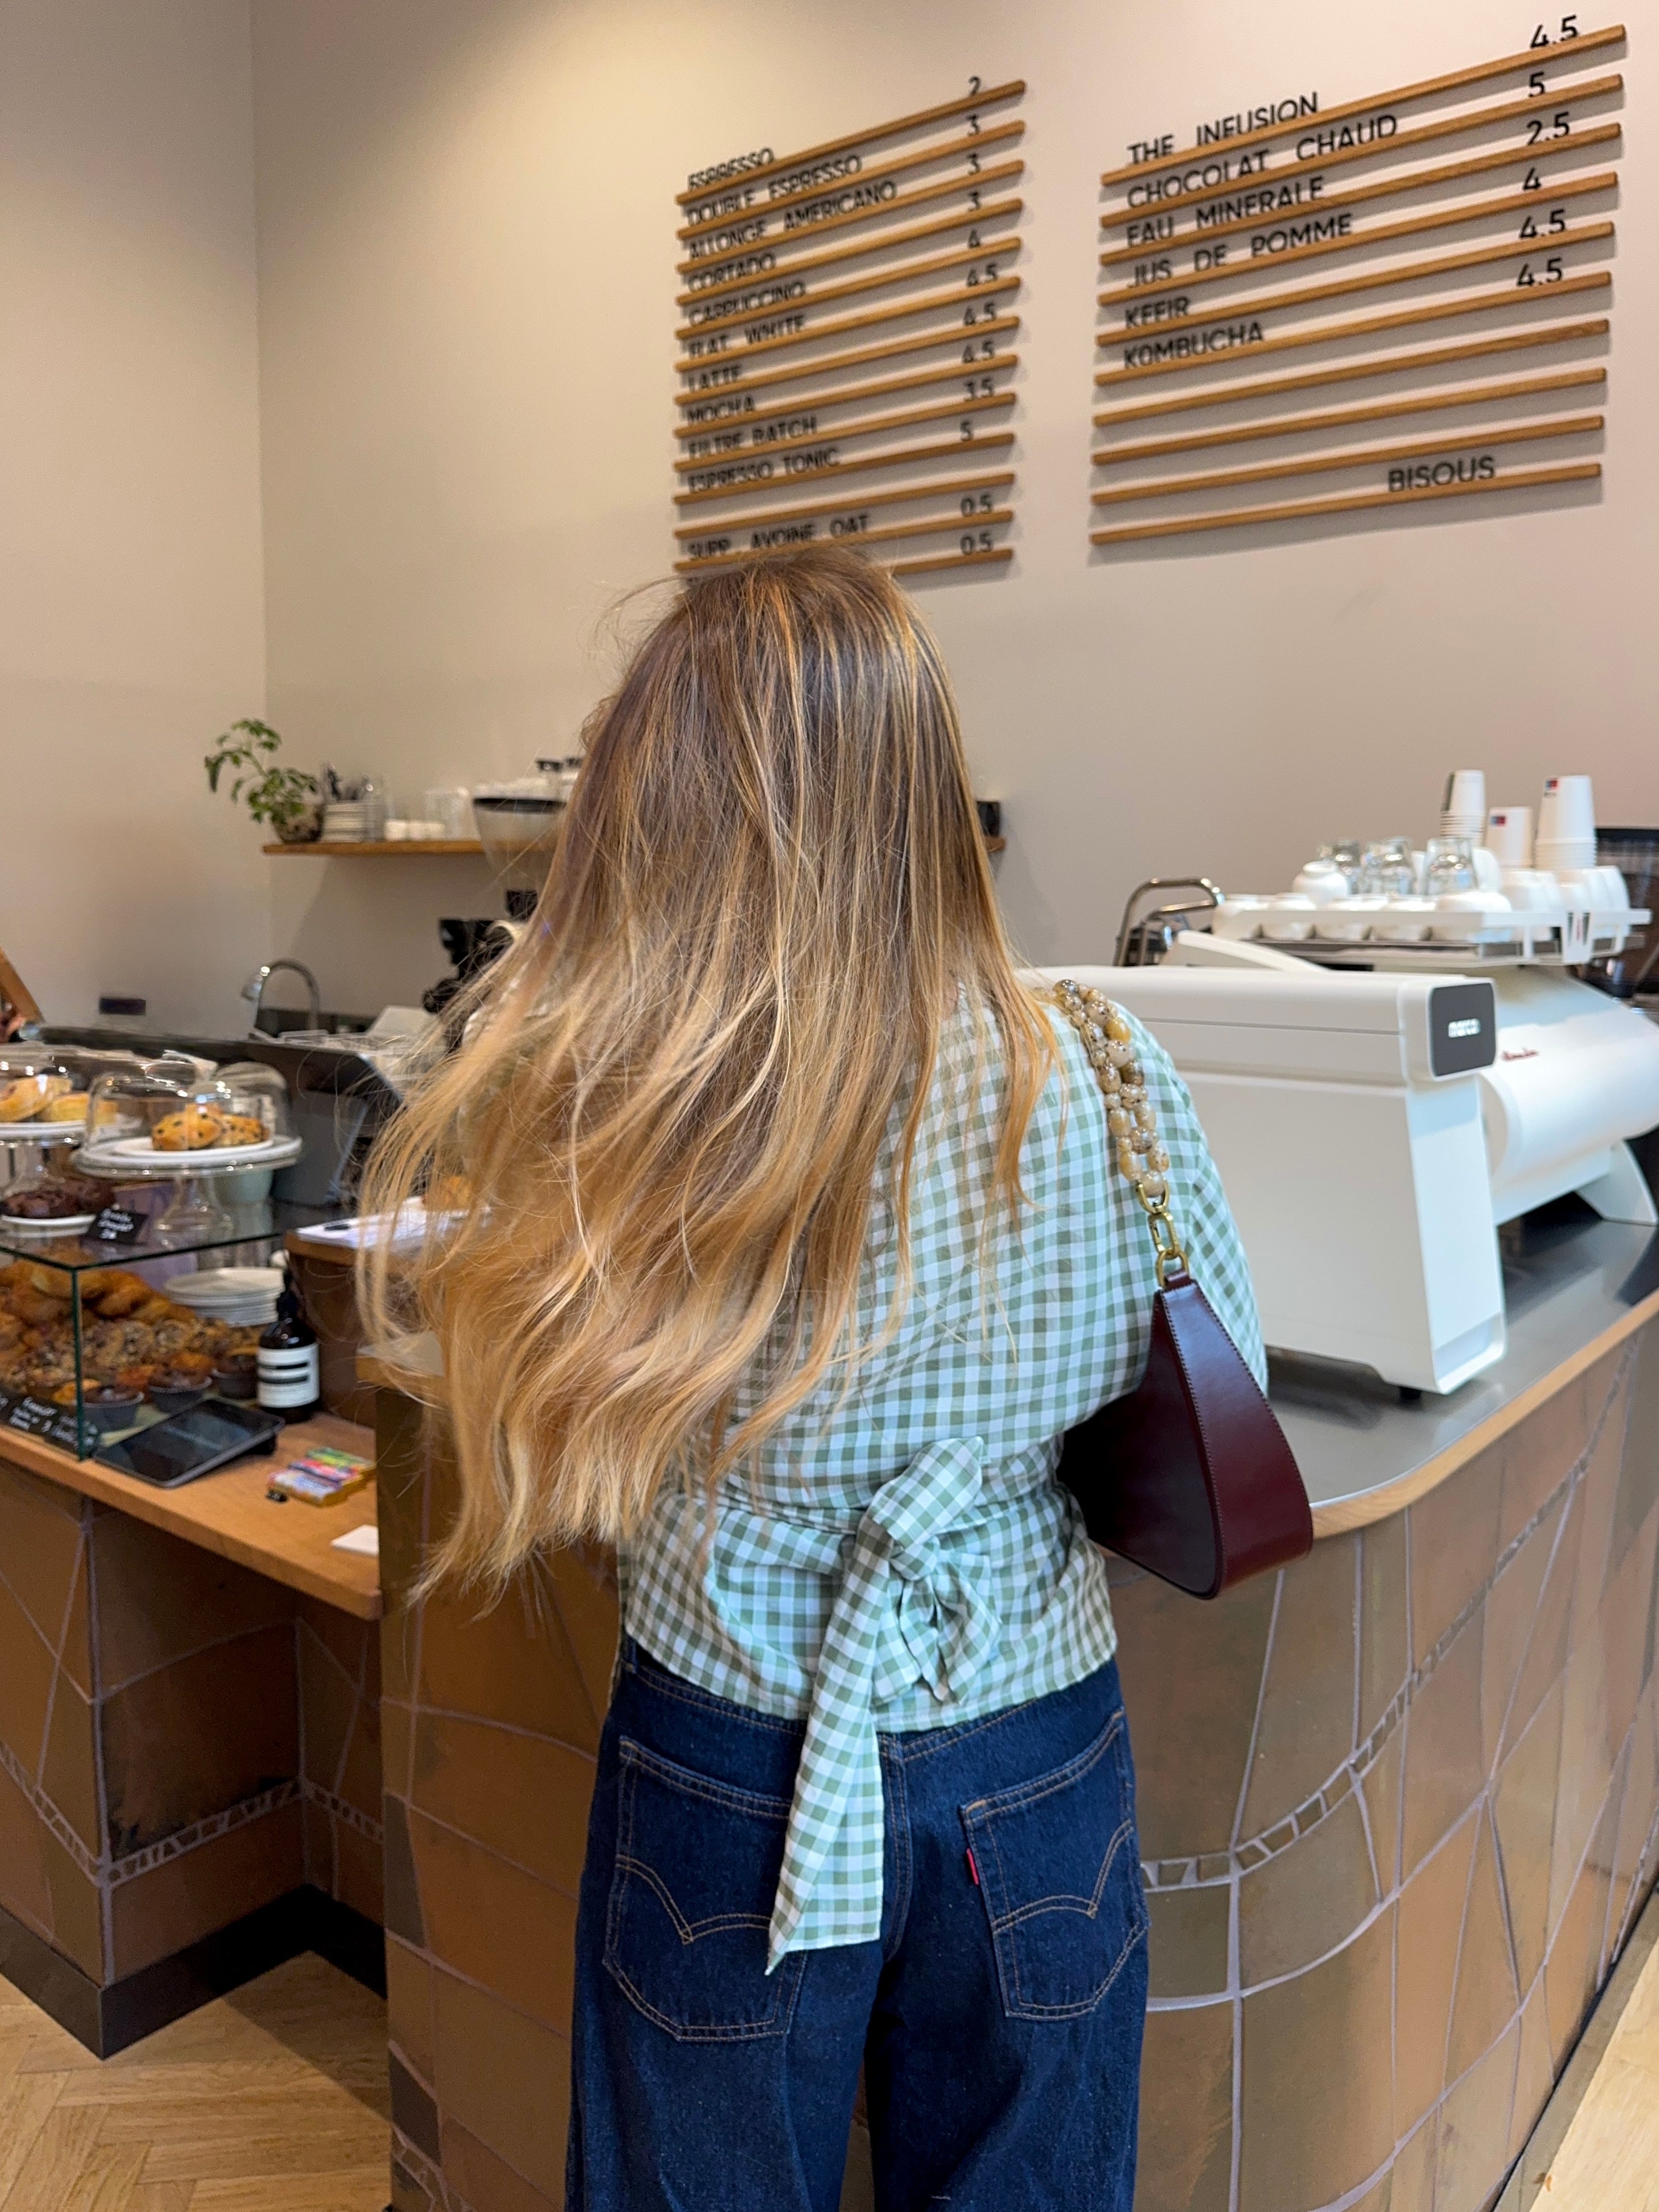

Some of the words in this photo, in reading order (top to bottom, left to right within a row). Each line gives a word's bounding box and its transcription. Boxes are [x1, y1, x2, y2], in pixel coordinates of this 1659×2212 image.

[688, 148, 775, 190] ESPRESSO
[968, 75, 981, 96] 2
[1127, 134, 1174, 166] THE
[1196, 91, 1319, 147] INFUSION
[1530, 14, 1578, 48] 4.5
[1127, 149, 1269, 208] CHOCOLAT
[1296, 114, 1397, 161] CHAUD
[1528, 71, 1545, 97] 5
[688, 189, 756, 225] DOUBLE
[769, 155, 861, 200] ESPRESSO
[966, 113, 979, 136] 3
[784, 181, 896, 230] AMERICANO
[966, 152, 980, 175] 3
[1126, 215, 1174, 248] EAU
[1196, 175, 1324, 228] MINERALE
[1526, 112, 1570, 146] 2.5
[689, 252, 775, 292] CORTADO
[967, 191, 980, 212] 3
[689, 282, 805, 325] CAPPUCCINO
[967, 228, 980, 249] 4
[1124, 296, 1191, 329] KEFIR
[1519, 207, 1566, 238] 4.5
[1128, 258, 1172, 288] JUS
[1194, 243, 1229, 272] DE
[1250, 212, 1353, 256] POMME
[1522, 167, 1542, 190] 4
[745, 315, 804, 344] WHITE
[1123, 321, 1263, 369] KOMBUCHA
[1516, 257, 1562, 286] 4.5
[688, 365, 741, 392] LATTE
[688, 395, 755, 424] MOCHA
[688, 461, 774, 492] ESPRESSO
[783, 447, 840, 475] TONIC
[960, 419, 974, 442] 5
[752, 416, 817, 445] BATCH
[1388, 454, 1495, 492] BISOUS
[750, 522, 815, 548] AVOINE
[829, 512, 869, 538] OAT
